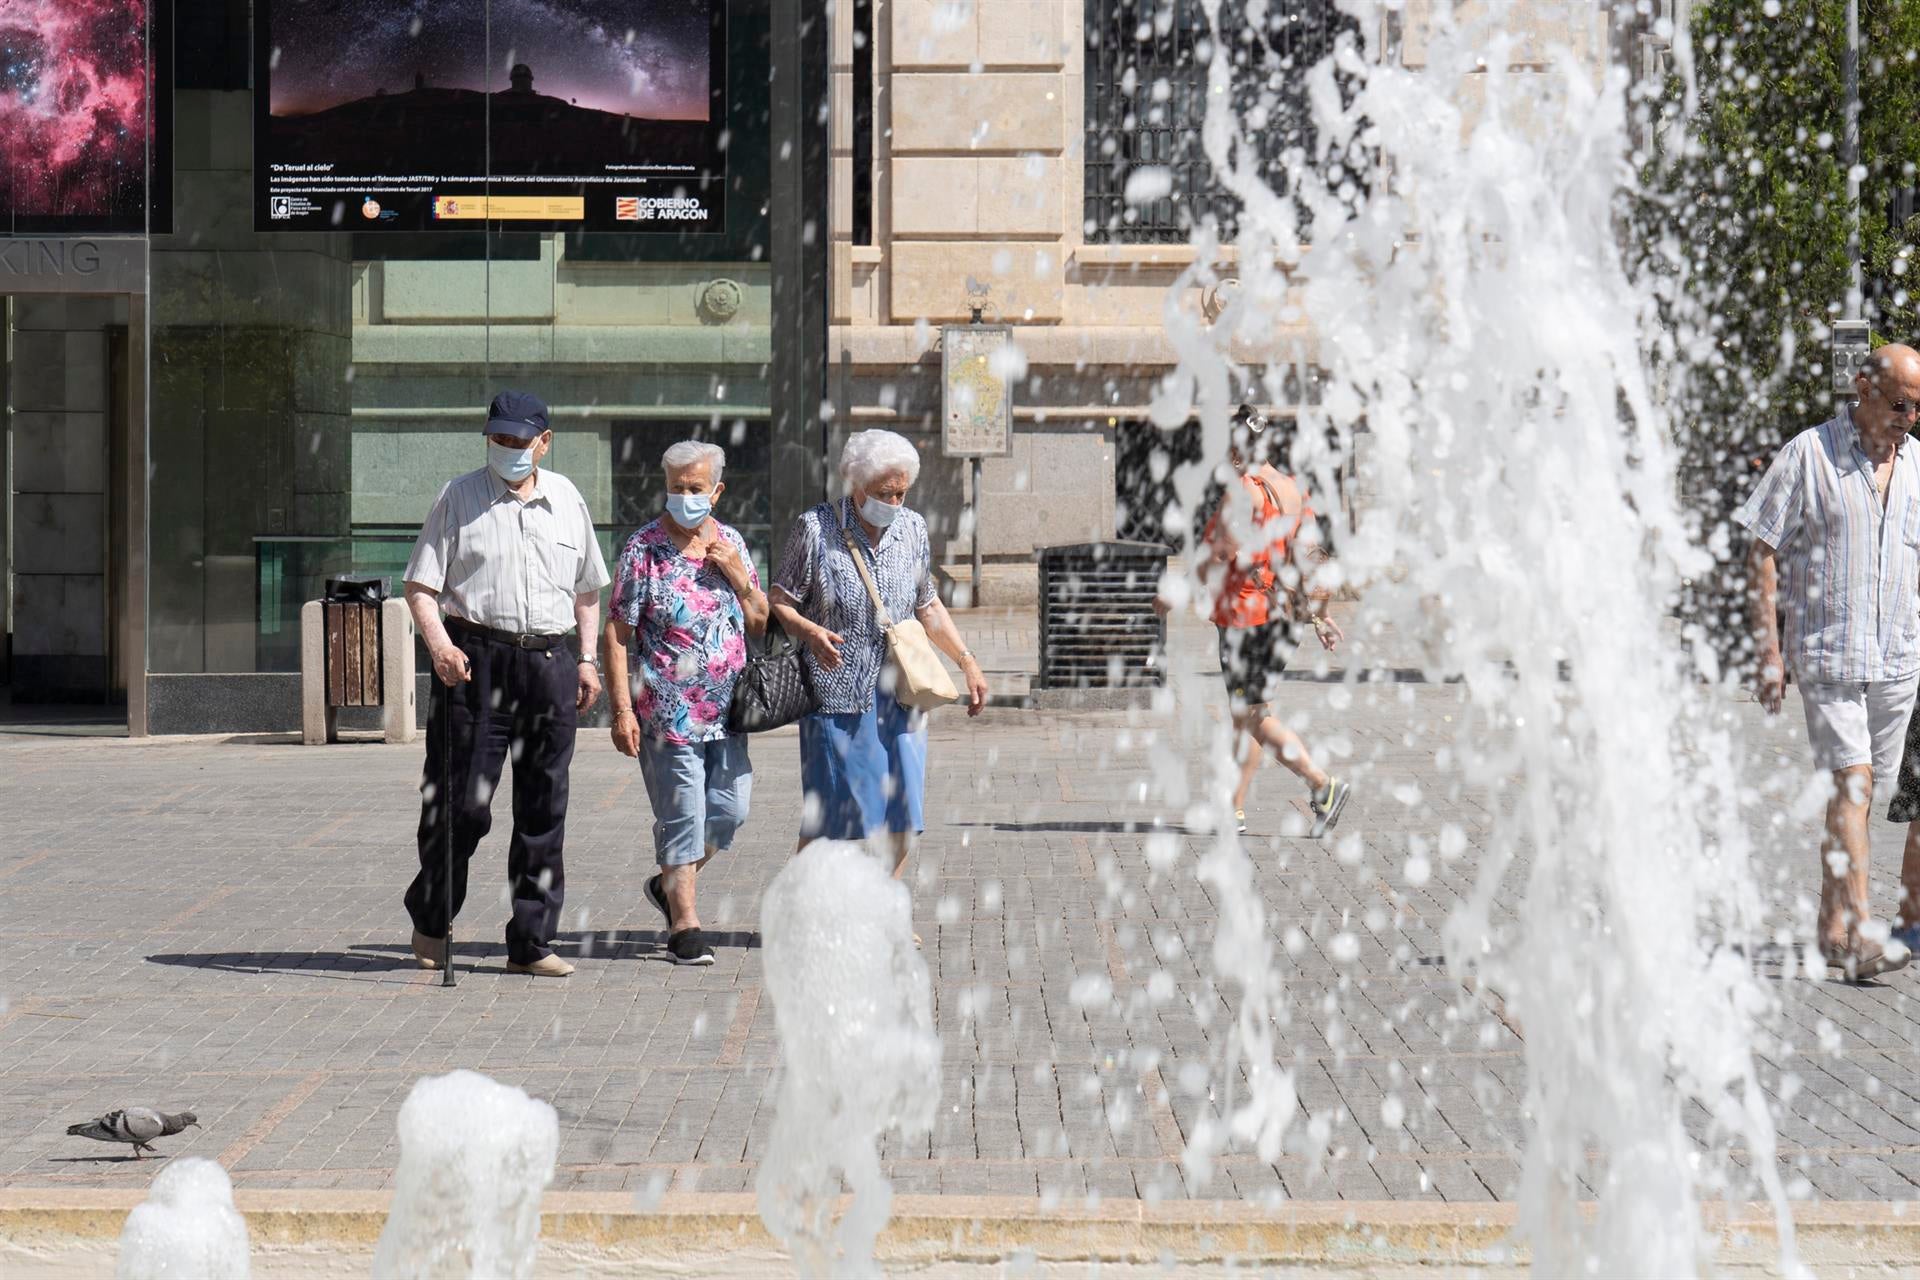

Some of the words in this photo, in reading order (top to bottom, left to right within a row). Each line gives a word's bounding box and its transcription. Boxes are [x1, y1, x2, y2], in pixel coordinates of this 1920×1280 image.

[281, 176, 308, 184] imágenes
[378, 176, 407, 184] Telescopio
[639, 198, 699, 209] GOBIERNO
[639, 209, 655, 219] DE
[657, 209, 708, 219] ARAGON
